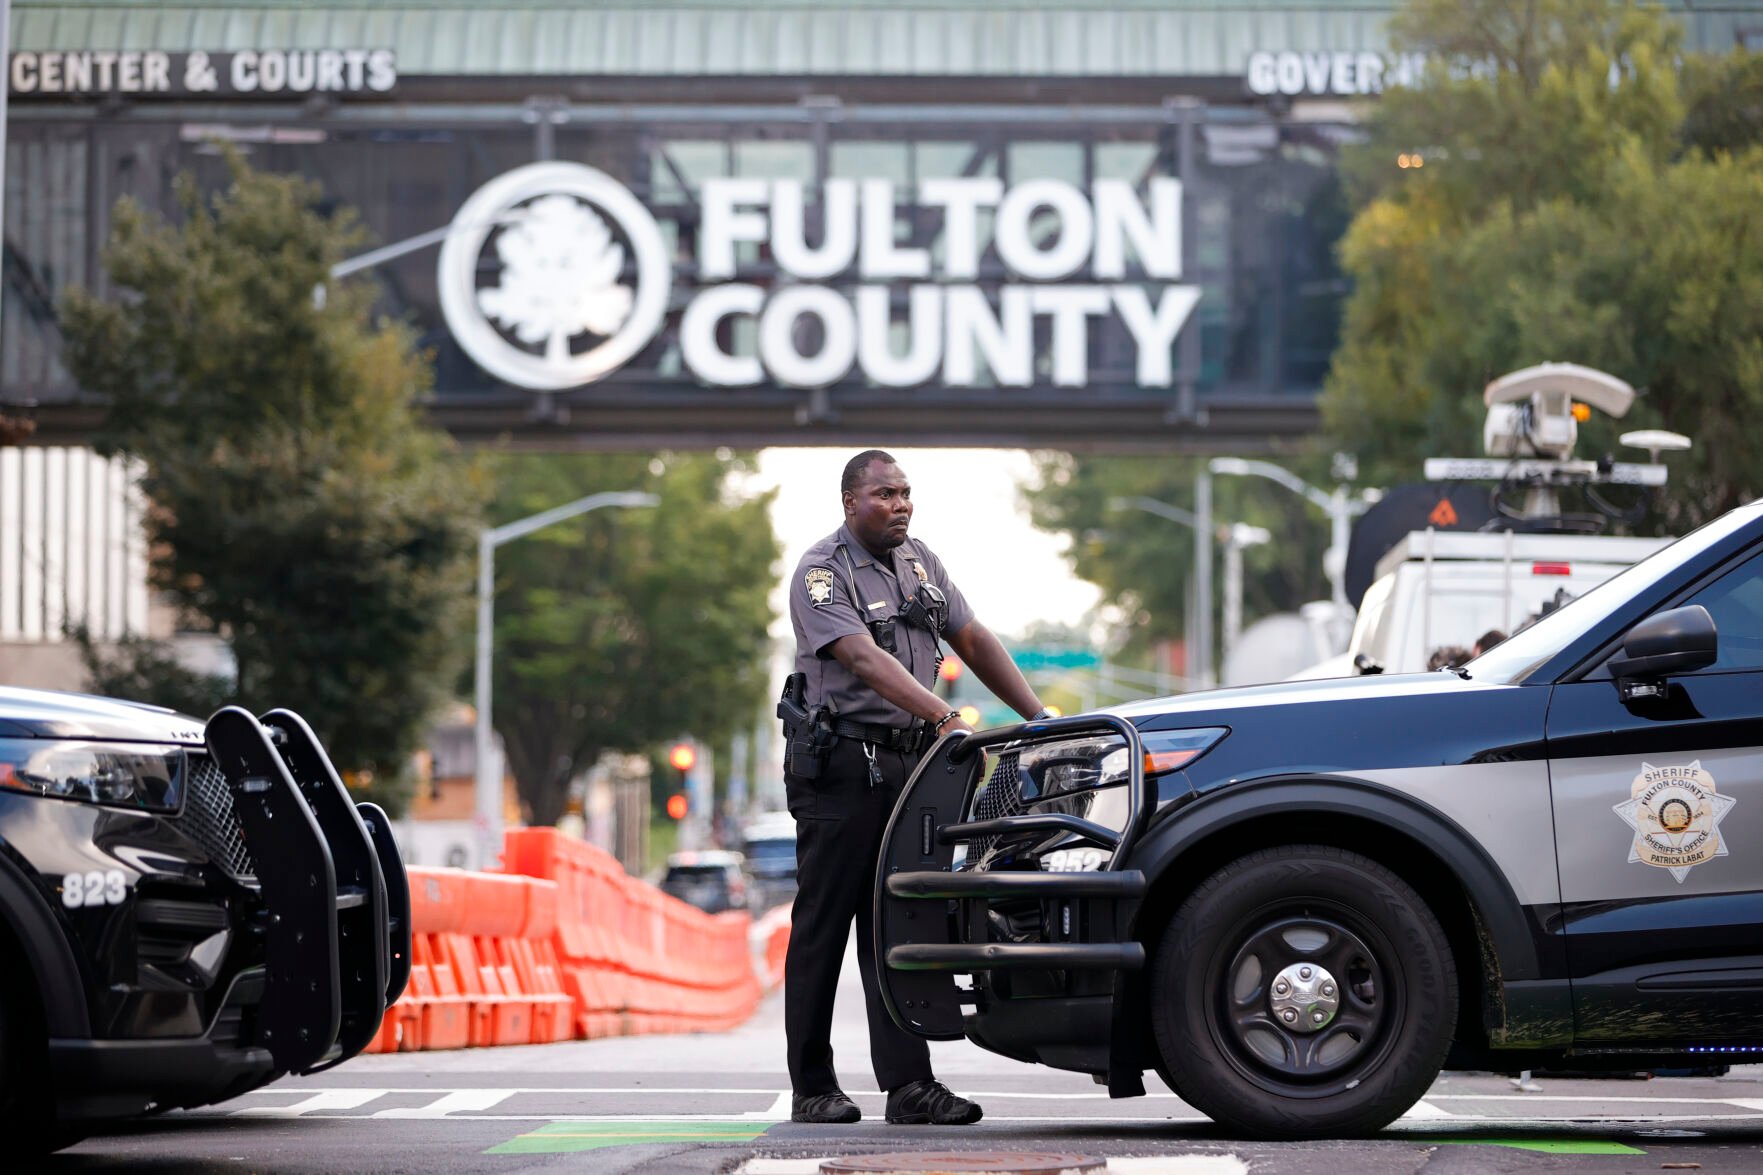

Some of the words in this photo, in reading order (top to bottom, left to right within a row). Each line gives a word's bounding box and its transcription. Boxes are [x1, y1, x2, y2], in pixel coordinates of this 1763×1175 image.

[10, 50, 171, 93] CENTER
[182, 50, 219, 93] &
[229, 50, 398, 93] COURTS
[1247, 50, 1427, 96] GOVER
[698, 176, 1184, 282] FULTON
[679, 283, 1202, 389] COUNTY
[1644, 768, 1698, 782] SHERIFF
[1641, 779, 1669, 806] FULTON
[1671, 779, 1706, 801] COUNTY
[1644, 833, 1683, 855] SHERIFF'S
[1684, 829, 1709, 852] OFFICE
[1650, 854, 1681, 865] PATRICK
[1682, 851, 1705, 864] LABAT
[1048, 850, 1102, 872] 952
[62, 870, 127, 908] 823
